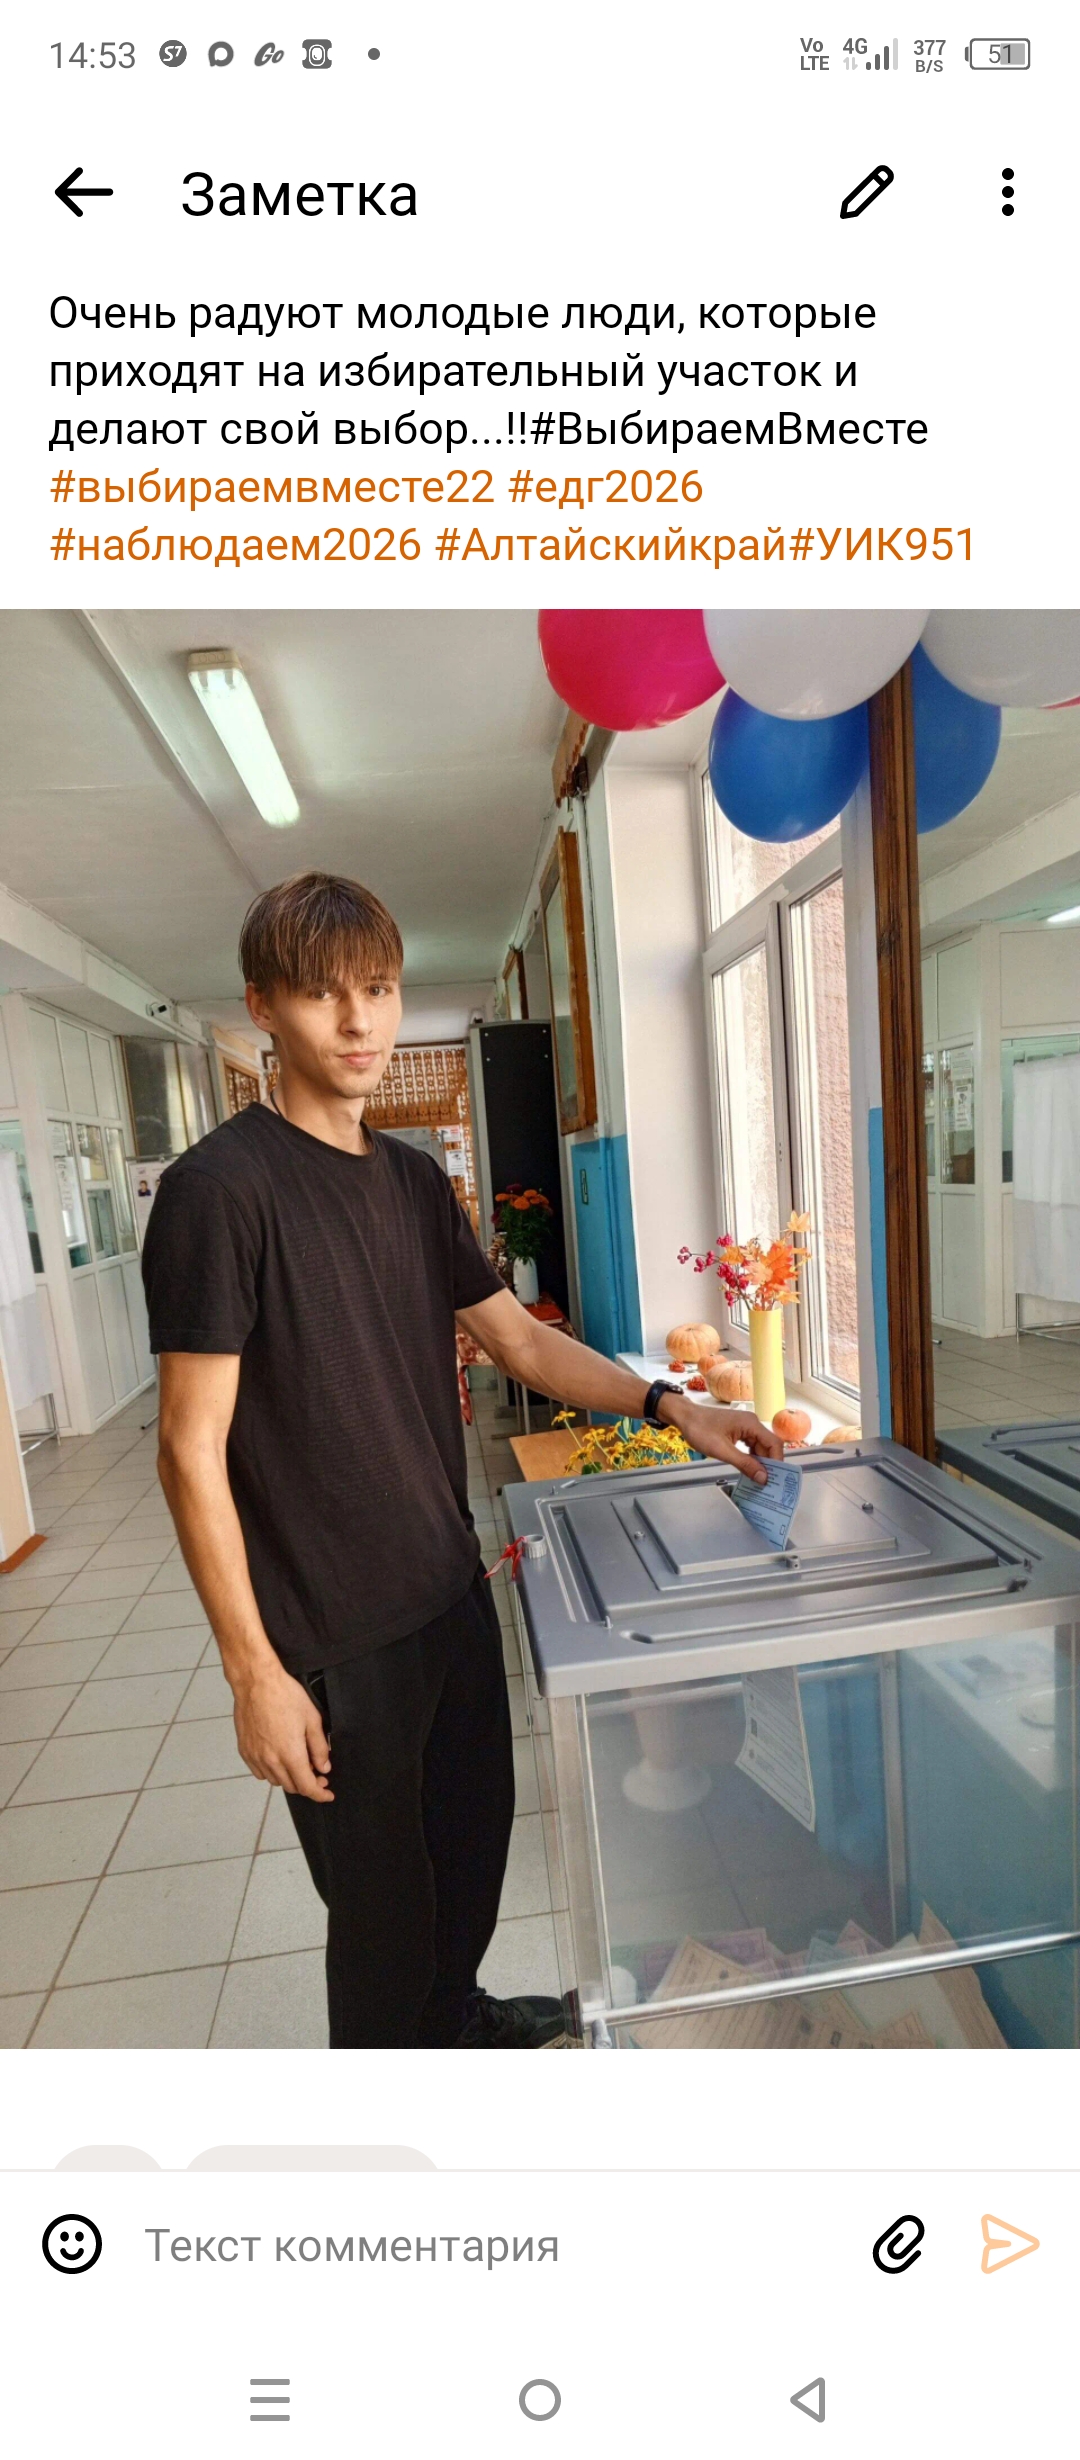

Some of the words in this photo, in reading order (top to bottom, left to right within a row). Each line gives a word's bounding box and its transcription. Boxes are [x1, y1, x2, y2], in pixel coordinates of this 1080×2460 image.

[51, 42, 135, 68] 14:53
[254, 42, 285, 66] Go
[800, 38, 824, 52] Vo
[843, 38, 868, 54] 4G
[914, 40, 946, 55] 377
[988, 44, 1013, 63] 51
[800, 56, 829, 70] LTE
[915, 60, 944, 73] B/S
[182, 172, 417, 216] Заметка
[50, 296, 175, 328] Очень
[191, 304, 343, 337] радуют
[358, 304, 548, 335] молодые
[562, 304, 684, 335] люди,
[700, 304, 875, 337] которые
[51, 362, 244, 395] приходят
[259, 362, 304, 386] на
[320, 352, 643, 395] избирательный
[657, 362, 822, 395] участок
[836, 362, 856, 386] и
[49, 420, 207, 451] делают
[221, 411, 318, 444] свой
[335, 410, 927, 453] выбор...!!#ВыбираемВместе
[50, 468, 494, 511] #выбираемвместе22
[508, 470, 702, 509] #едг2026
[50, 526, 420, 567] #наблюдаем2026
[435, 527, 974, 569] #Алтайскийкрай#УИК951
[145, 2229, 261, 2261] Текст
[277, 2237, 557, 2270] комментария
